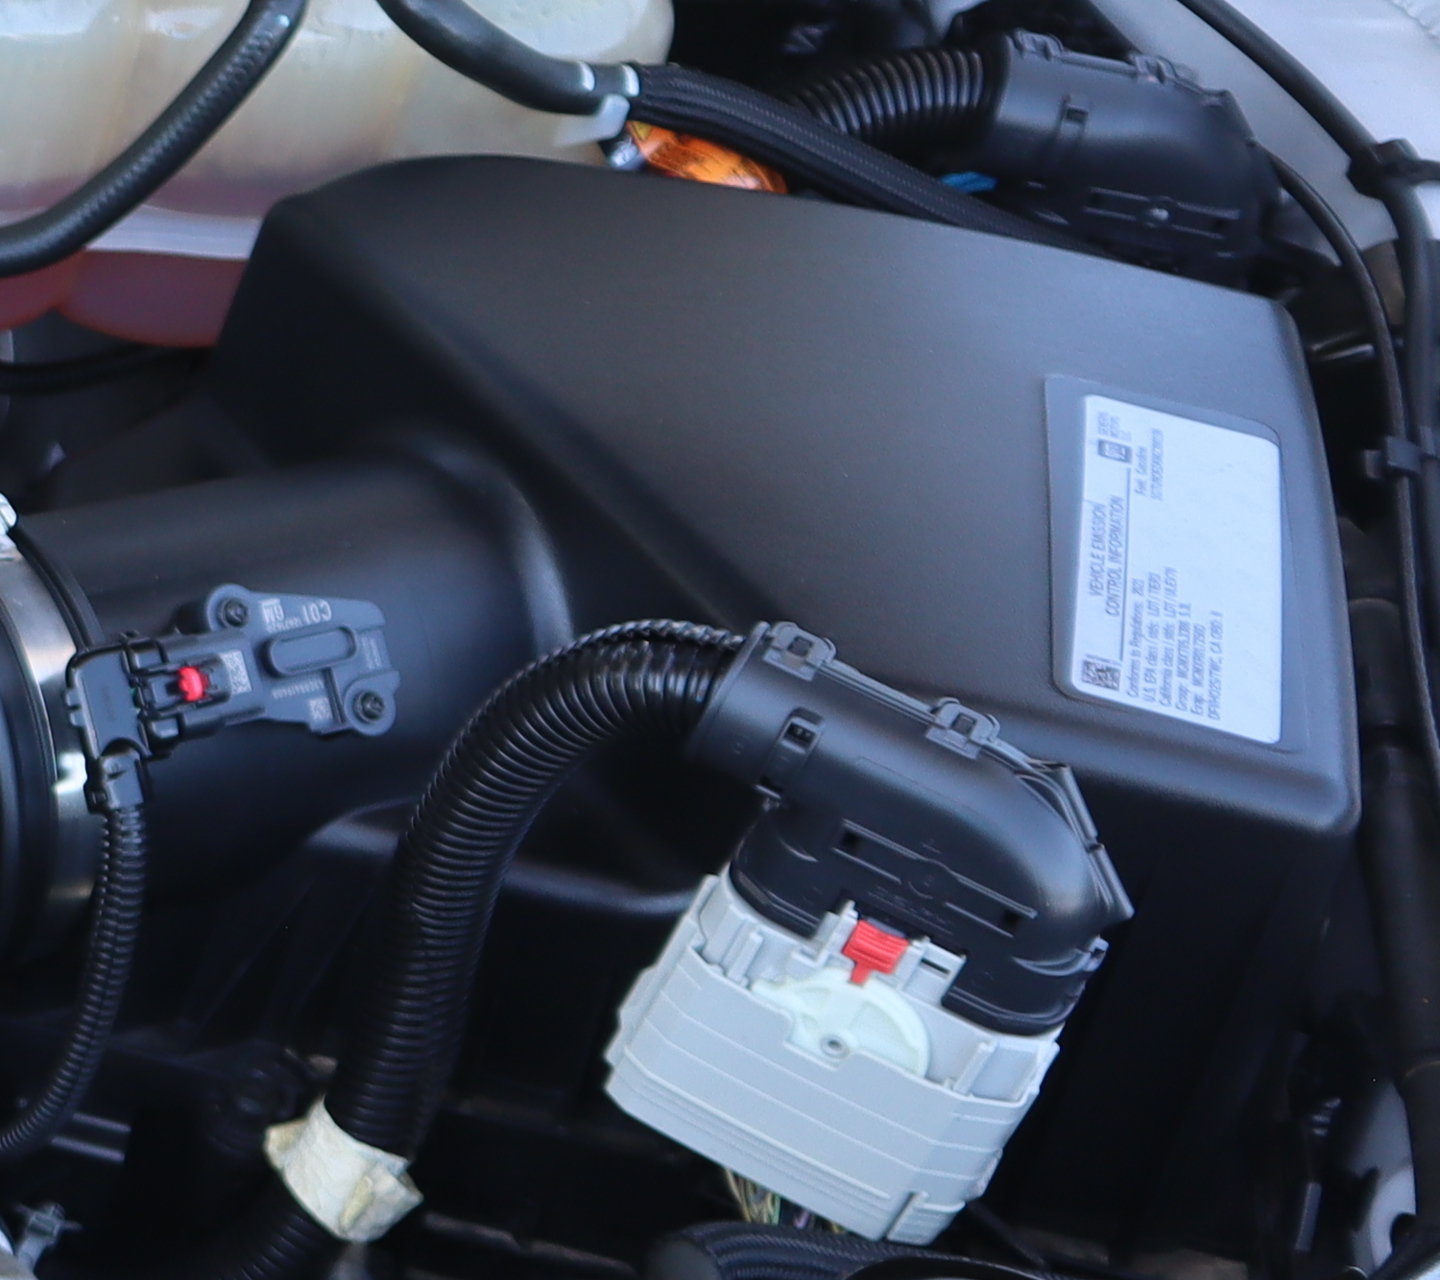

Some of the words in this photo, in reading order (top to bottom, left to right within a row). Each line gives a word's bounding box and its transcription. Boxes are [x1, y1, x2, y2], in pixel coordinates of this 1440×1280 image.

[1090, 501, 1107, 551] EMISSION
[1107, 494, 1124, 565] INFORMATION
[1088, 550, 1105, 598] VEHICLE
[1104, 564, 1121, 617] CONTROL
[1144, 666, 1157, 685] EPA
